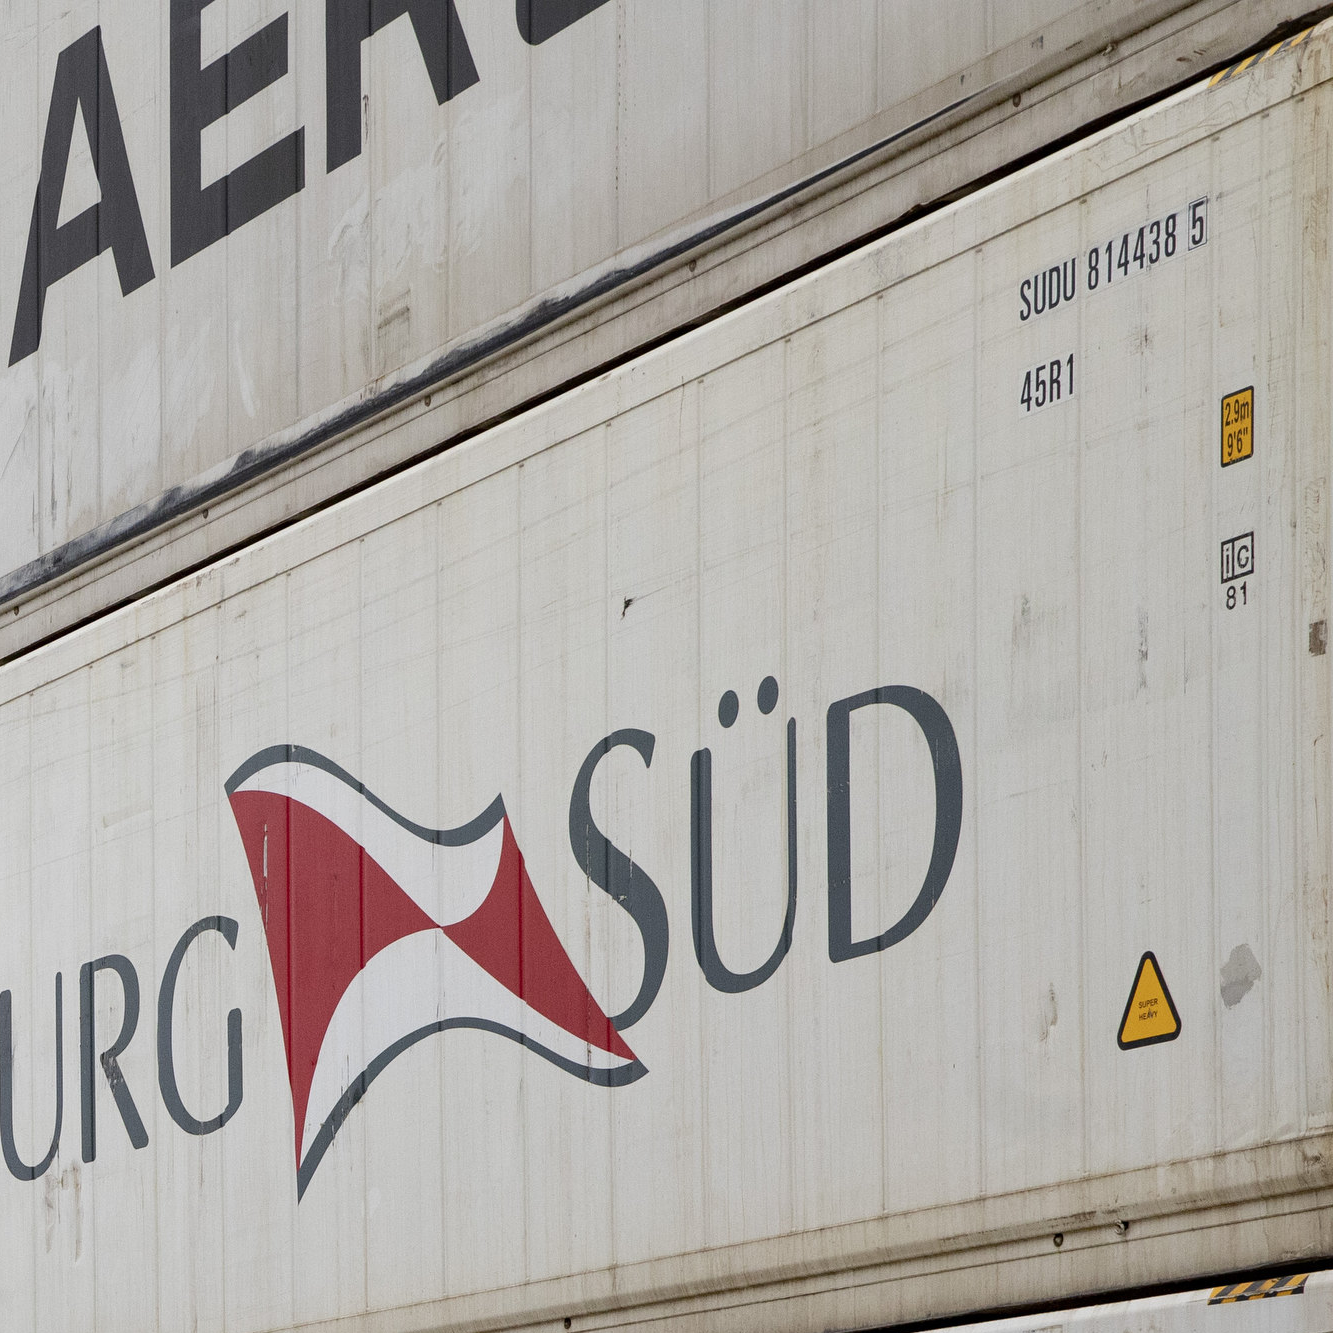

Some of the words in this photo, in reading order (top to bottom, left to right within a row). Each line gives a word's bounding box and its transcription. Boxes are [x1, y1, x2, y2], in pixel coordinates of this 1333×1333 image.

[1019, 256, 1077, 323] SUDU
[1086, 213, 1178, 291] 814438
[1189, 198, 1206, 247] 5
[1019, 352, 1075, 413] 45R1
[1224, 398, 1250, 428] 2.9m
[1226, 428, 1249, 458] 9'6"
[1225, 580, 1250, 611] 81
[567, 674, 965, 1034] SÜD
[1137, 997, 1159, 1010] SUPER
[1138, 1009, 1159, 1022] HEAVY
